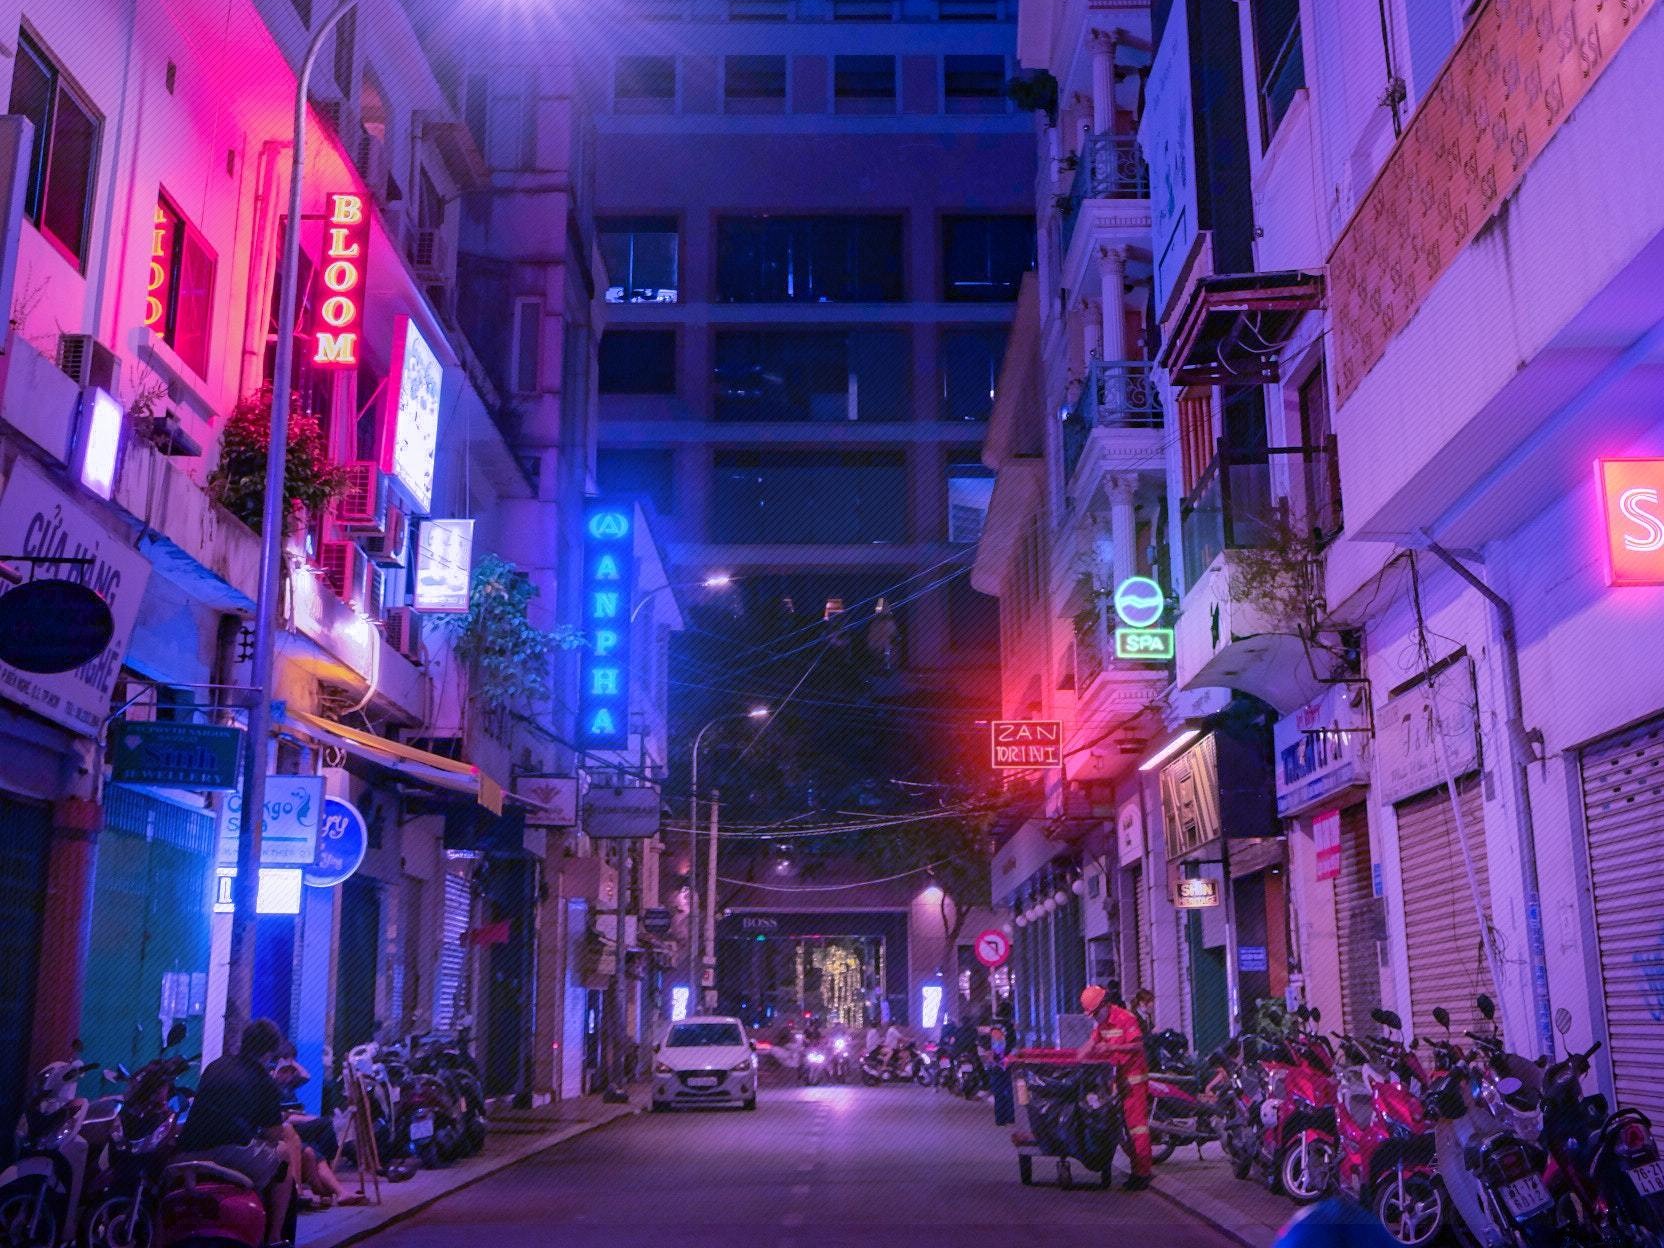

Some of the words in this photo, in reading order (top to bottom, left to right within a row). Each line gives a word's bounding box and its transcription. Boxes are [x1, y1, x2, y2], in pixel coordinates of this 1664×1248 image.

[313, 194, 363, 364] BLOOM
[591, 554, 621, 735] ANPHA
[1125, 634, 1165, 652] SPA
[998, 724, 1058, 742] ZAN
[742, 917, 778, 929] BOSS
